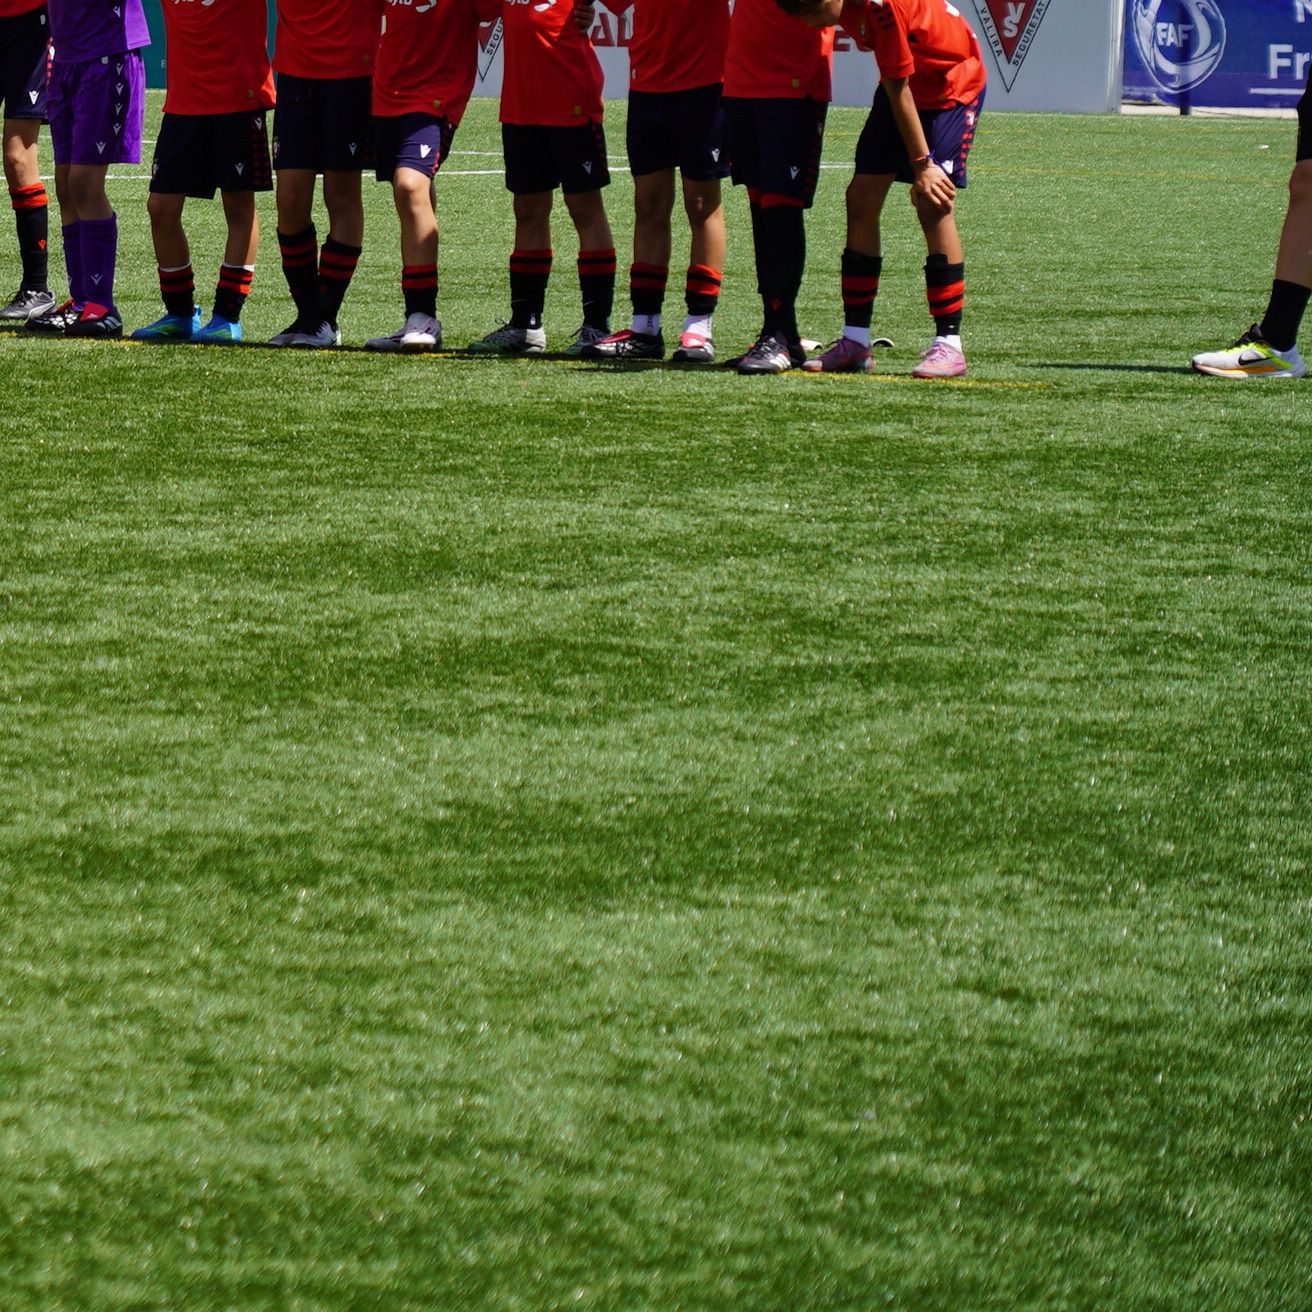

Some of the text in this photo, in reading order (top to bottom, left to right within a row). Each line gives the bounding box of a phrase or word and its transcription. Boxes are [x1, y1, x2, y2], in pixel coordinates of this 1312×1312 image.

[980, 6, 1003, 58] VALIRA
[1012, 0, 1046, 67] SEGURETAT
[1156, 21, 1194, 48] FAF
